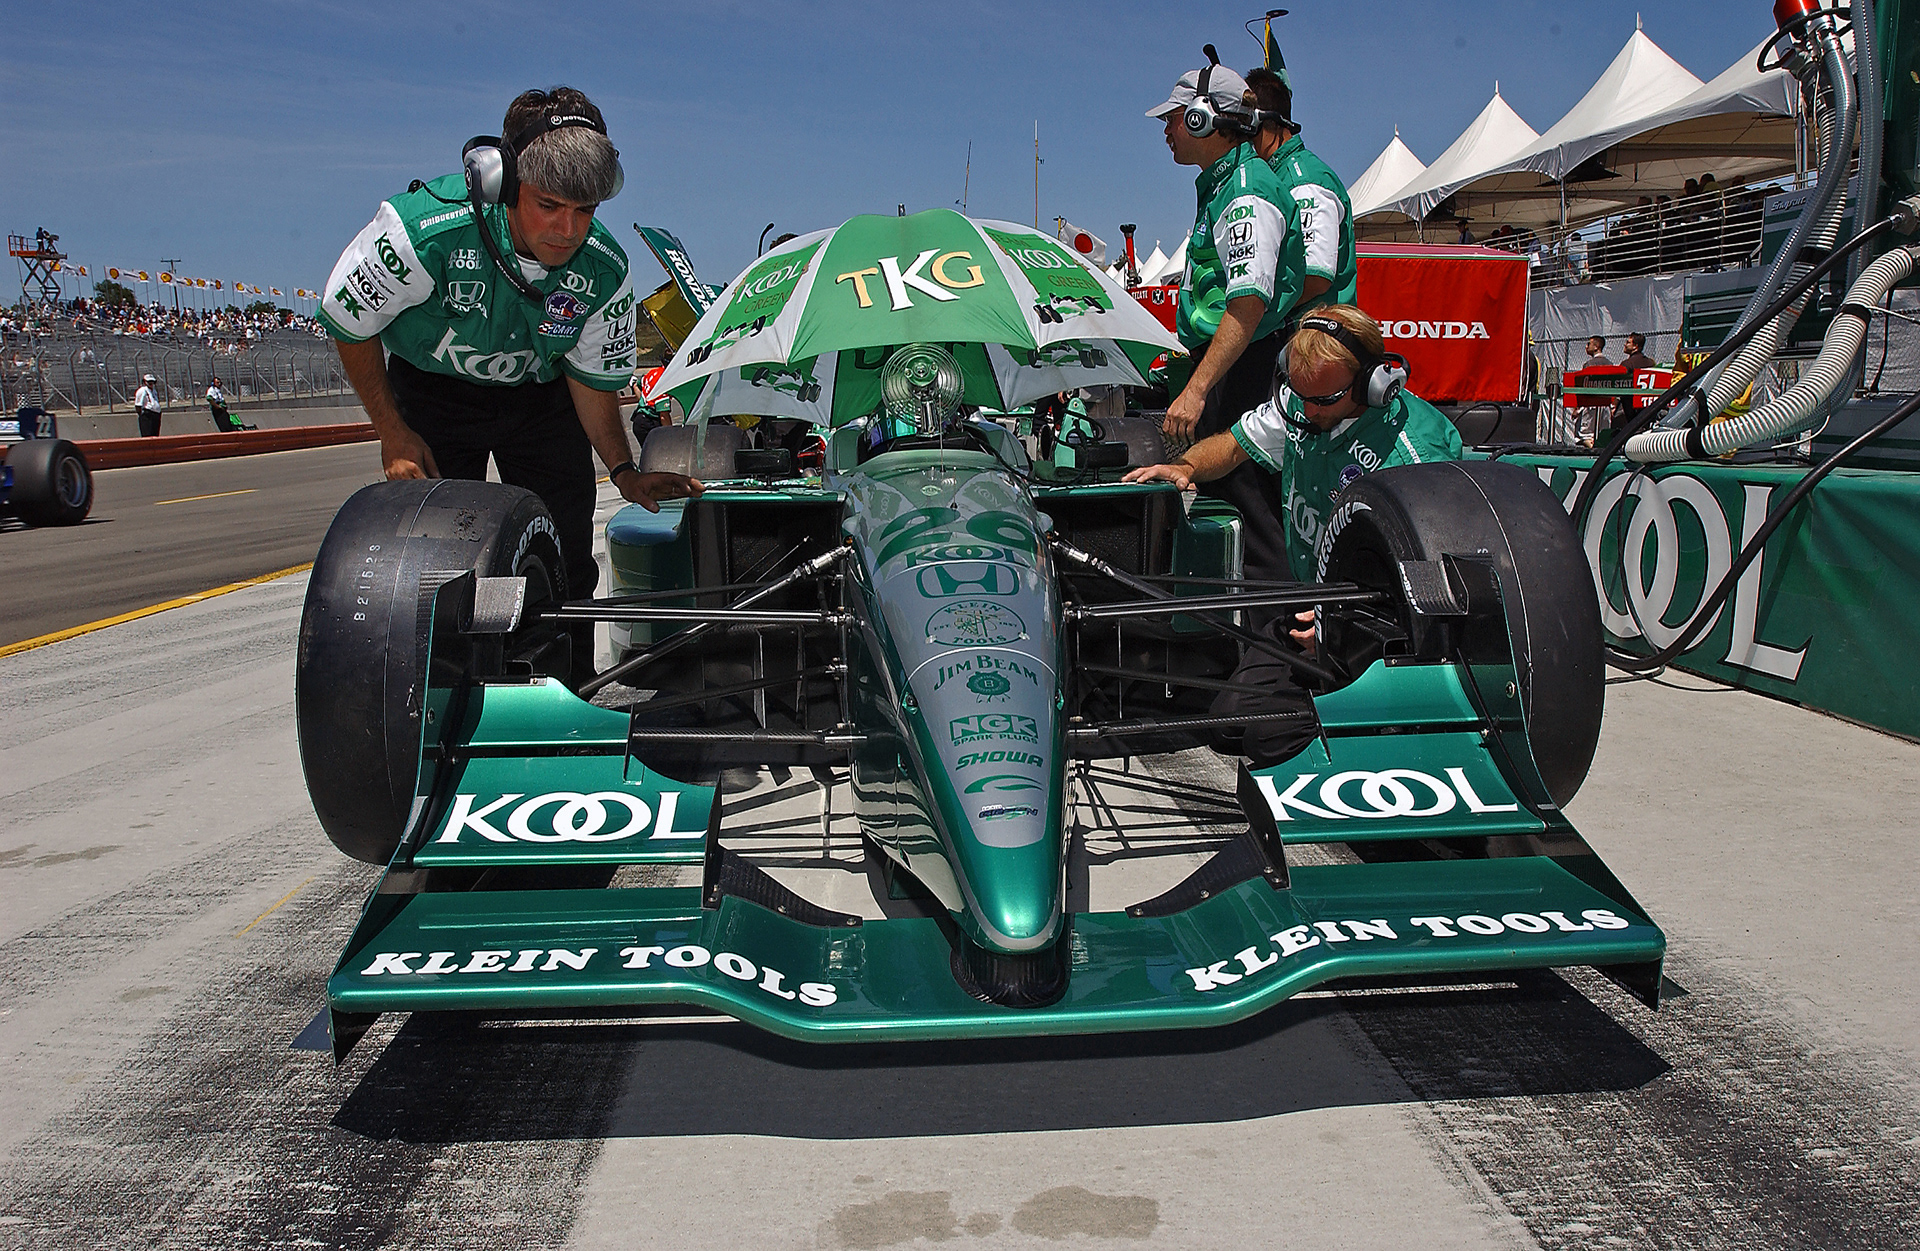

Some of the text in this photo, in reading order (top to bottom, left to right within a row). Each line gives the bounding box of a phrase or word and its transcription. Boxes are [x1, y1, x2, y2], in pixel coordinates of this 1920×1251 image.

[375, 231, 413, 286] KOOL
[1008, 248, 1078, 270] KOOL
[1228, 245, 1253, 262] NGK
[352, 269, 385, 308] NGK
[560, 270, 598, 298] OOL
[736, 260, 801, 304] KOOL
[836, 248, 985, 311] TKG
[602, 332, 635, 355] NGK
[1614, 379, 1634, 389] STAT
[873, 507, 1039, 577] 26
[943, 602, 1002, 614] KLEIN
[952, 635, 1007, 645] TOOLS
[933, 659, 972, 692] JIM
[976, 654, 1039, 687] BEAM
[952, 713, 1036, 739] NGK
[953, 733, 1039, 748] SPARK PLUGS
[955, 750, 1044, 772] SHOWA
[1253, 767, 1518, 821] KOOL
[435, 791, 708, 843] KOOL
[1185, 908, 1629, 992] KLEIN TOOLS
[360, 945, 837, 1008] KLEIN TOOLS
